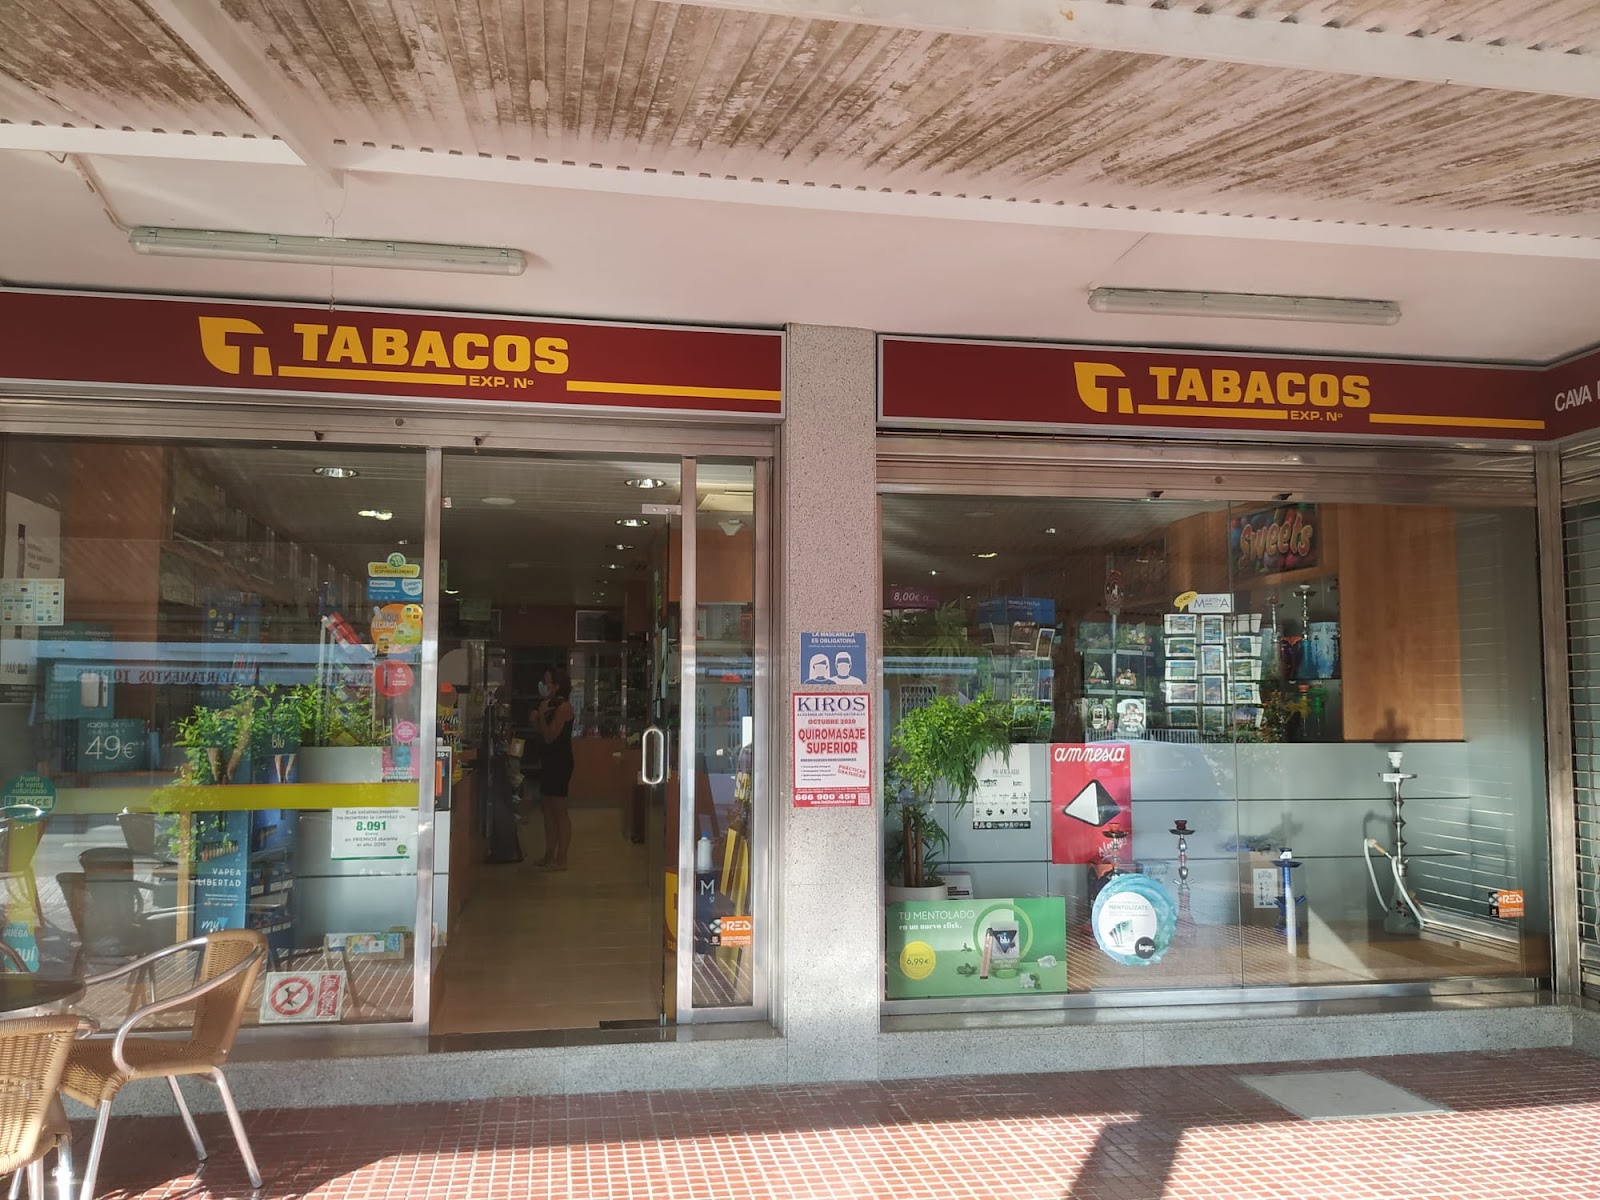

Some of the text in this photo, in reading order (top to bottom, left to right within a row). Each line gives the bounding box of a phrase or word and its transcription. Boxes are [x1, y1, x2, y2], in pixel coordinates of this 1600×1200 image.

[293, 323, 569, 374] TABACOS
[469, 375, 509, 388] EXP.
[1149, 366, 1371, 408] TABACOS
[1554, 384, 1592, 412] CAVA
[1290, 410, 1324, 421] EXP.
[797, 697, 866, 712] KIROS
[798, 728, 866, 742] QUIROMASAJE
[84, 735, 136, 760] 49€
[806, 742, 858, 754] SUPERIOR
[1054, 747, 1126, 762] amnesia
[356, 821, 386, 831] 8.091
[212, 868, 241, 876] VAPEA
[198, 879, 241, 887] LIBERTAD
[1502, 894, 1523, 904] RED
[899, 910, 975, 920] TU MENTOLADO
[726, 920, 751, 931] RED
[4, 928, 28, 938] JUEGA
[906, 957, 929, 966] 6,99€
